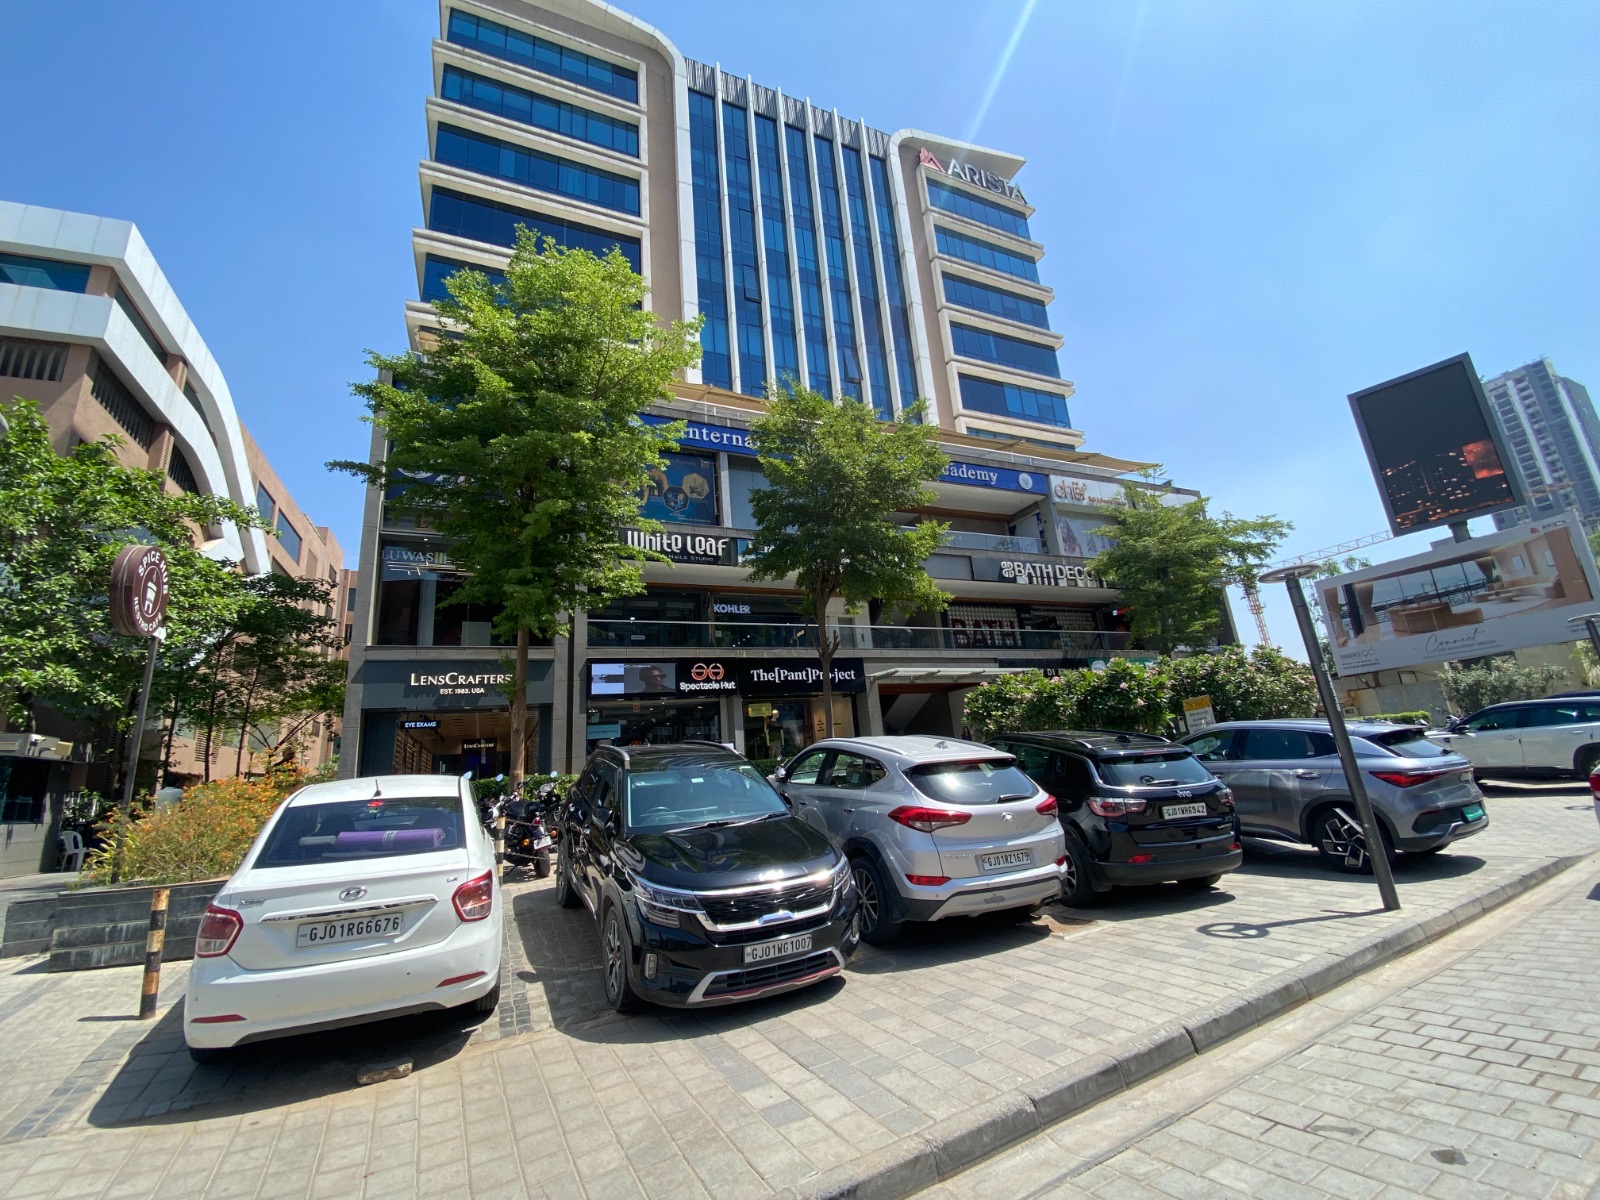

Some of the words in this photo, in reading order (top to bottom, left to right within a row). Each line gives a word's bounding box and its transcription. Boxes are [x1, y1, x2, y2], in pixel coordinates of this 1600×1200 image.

[947, 157, 1029, 206] ARISTA
[682, 426, 760, 448] nterna
[941, 463, 998, 485] cademy
[627, 530, 682, 553] White
[138, 550, 160, 577] SPICE
[1013, 561, 1054, 579] BATH
[1055, 564, 1098, 581] DECO
[713, 603, 751, 615] KOHLER
[679, 681, 720, 692] Spectacle
[720, 681, 736, 690] Hut
[309, 916, 400, 942] GJ01RG6676
